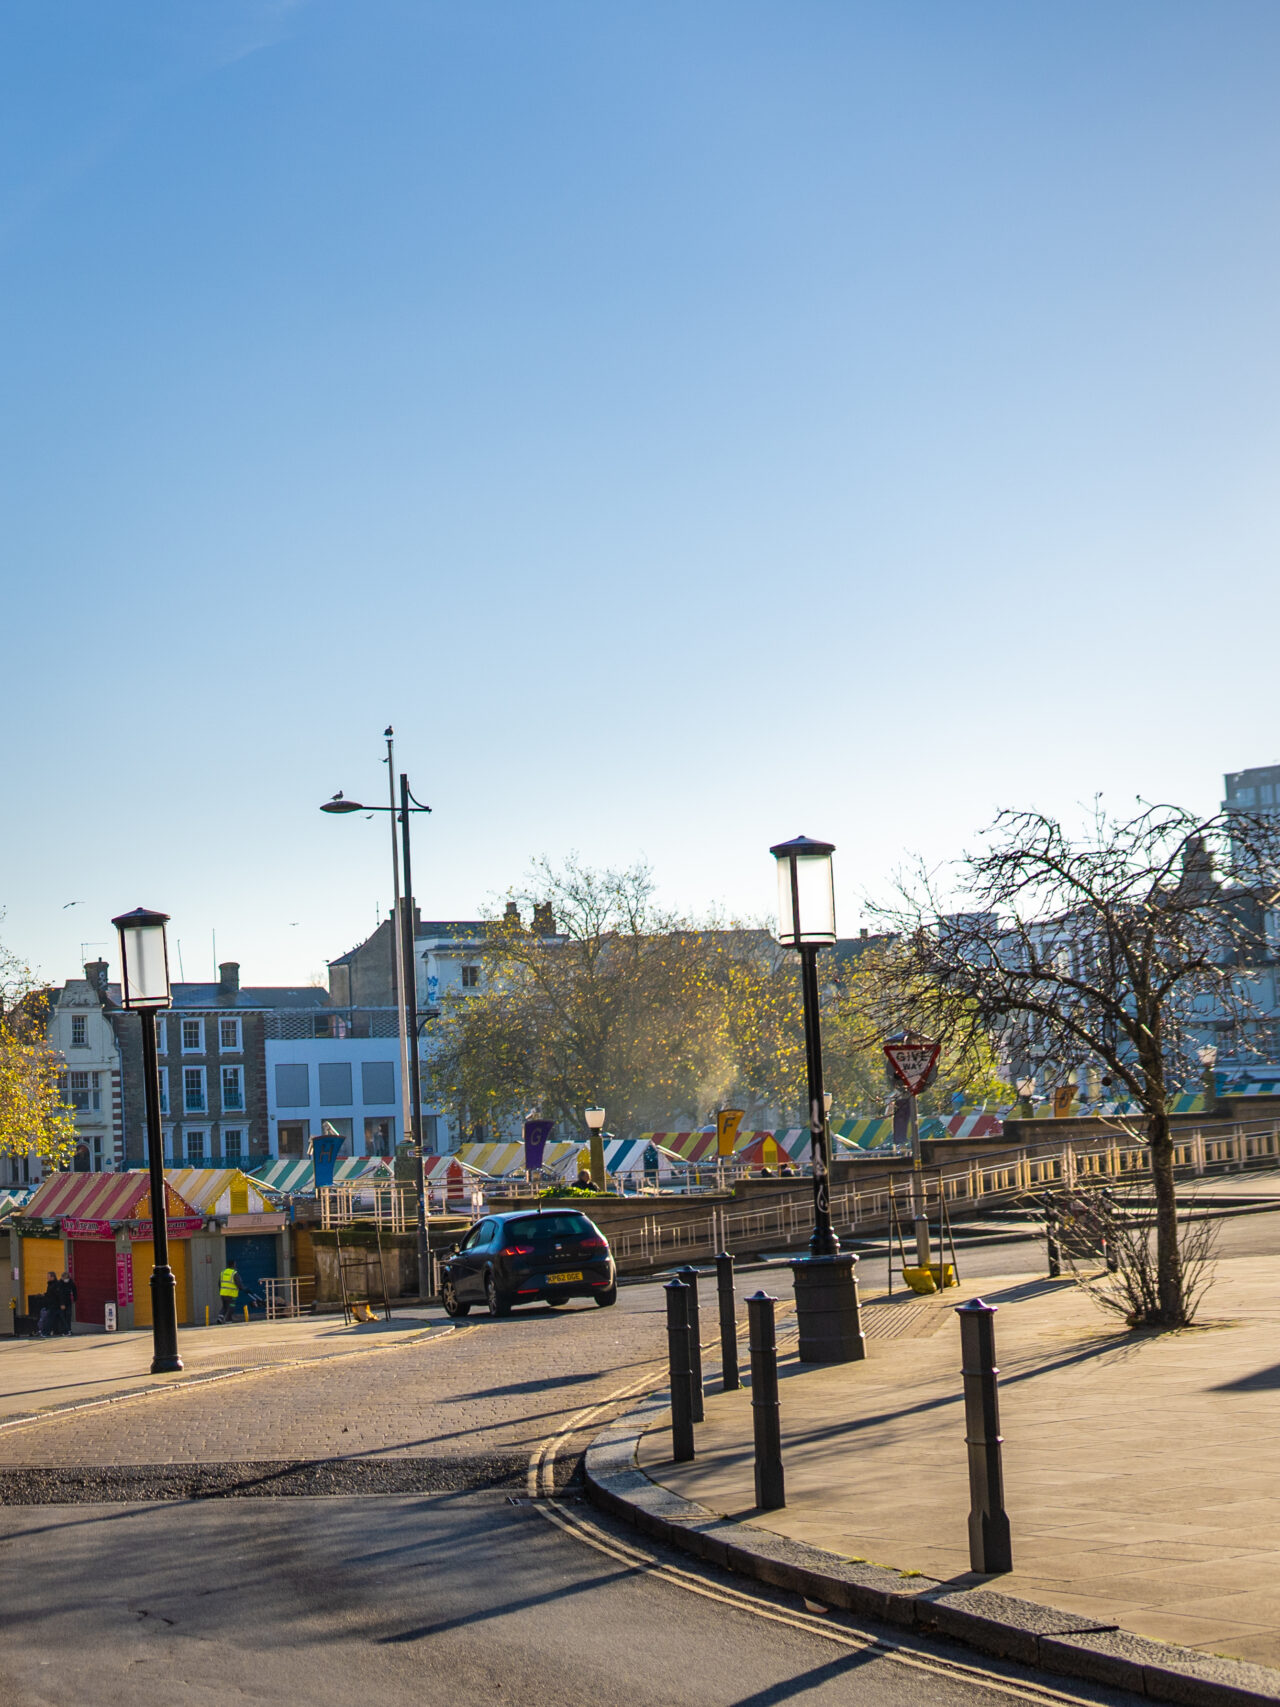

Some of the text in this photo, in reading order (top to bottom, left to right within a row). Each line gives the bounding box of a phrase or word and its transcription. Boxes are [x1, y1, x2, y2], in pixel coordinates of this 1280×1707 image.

[896, 1051, 929, 1062] GIVE
[903, 1062, 923, 1071] WAY
[723, 1116, 736, 1134] F
[531, 1128, 542, 1146] G
[320, 1144, 334, 1163] H
